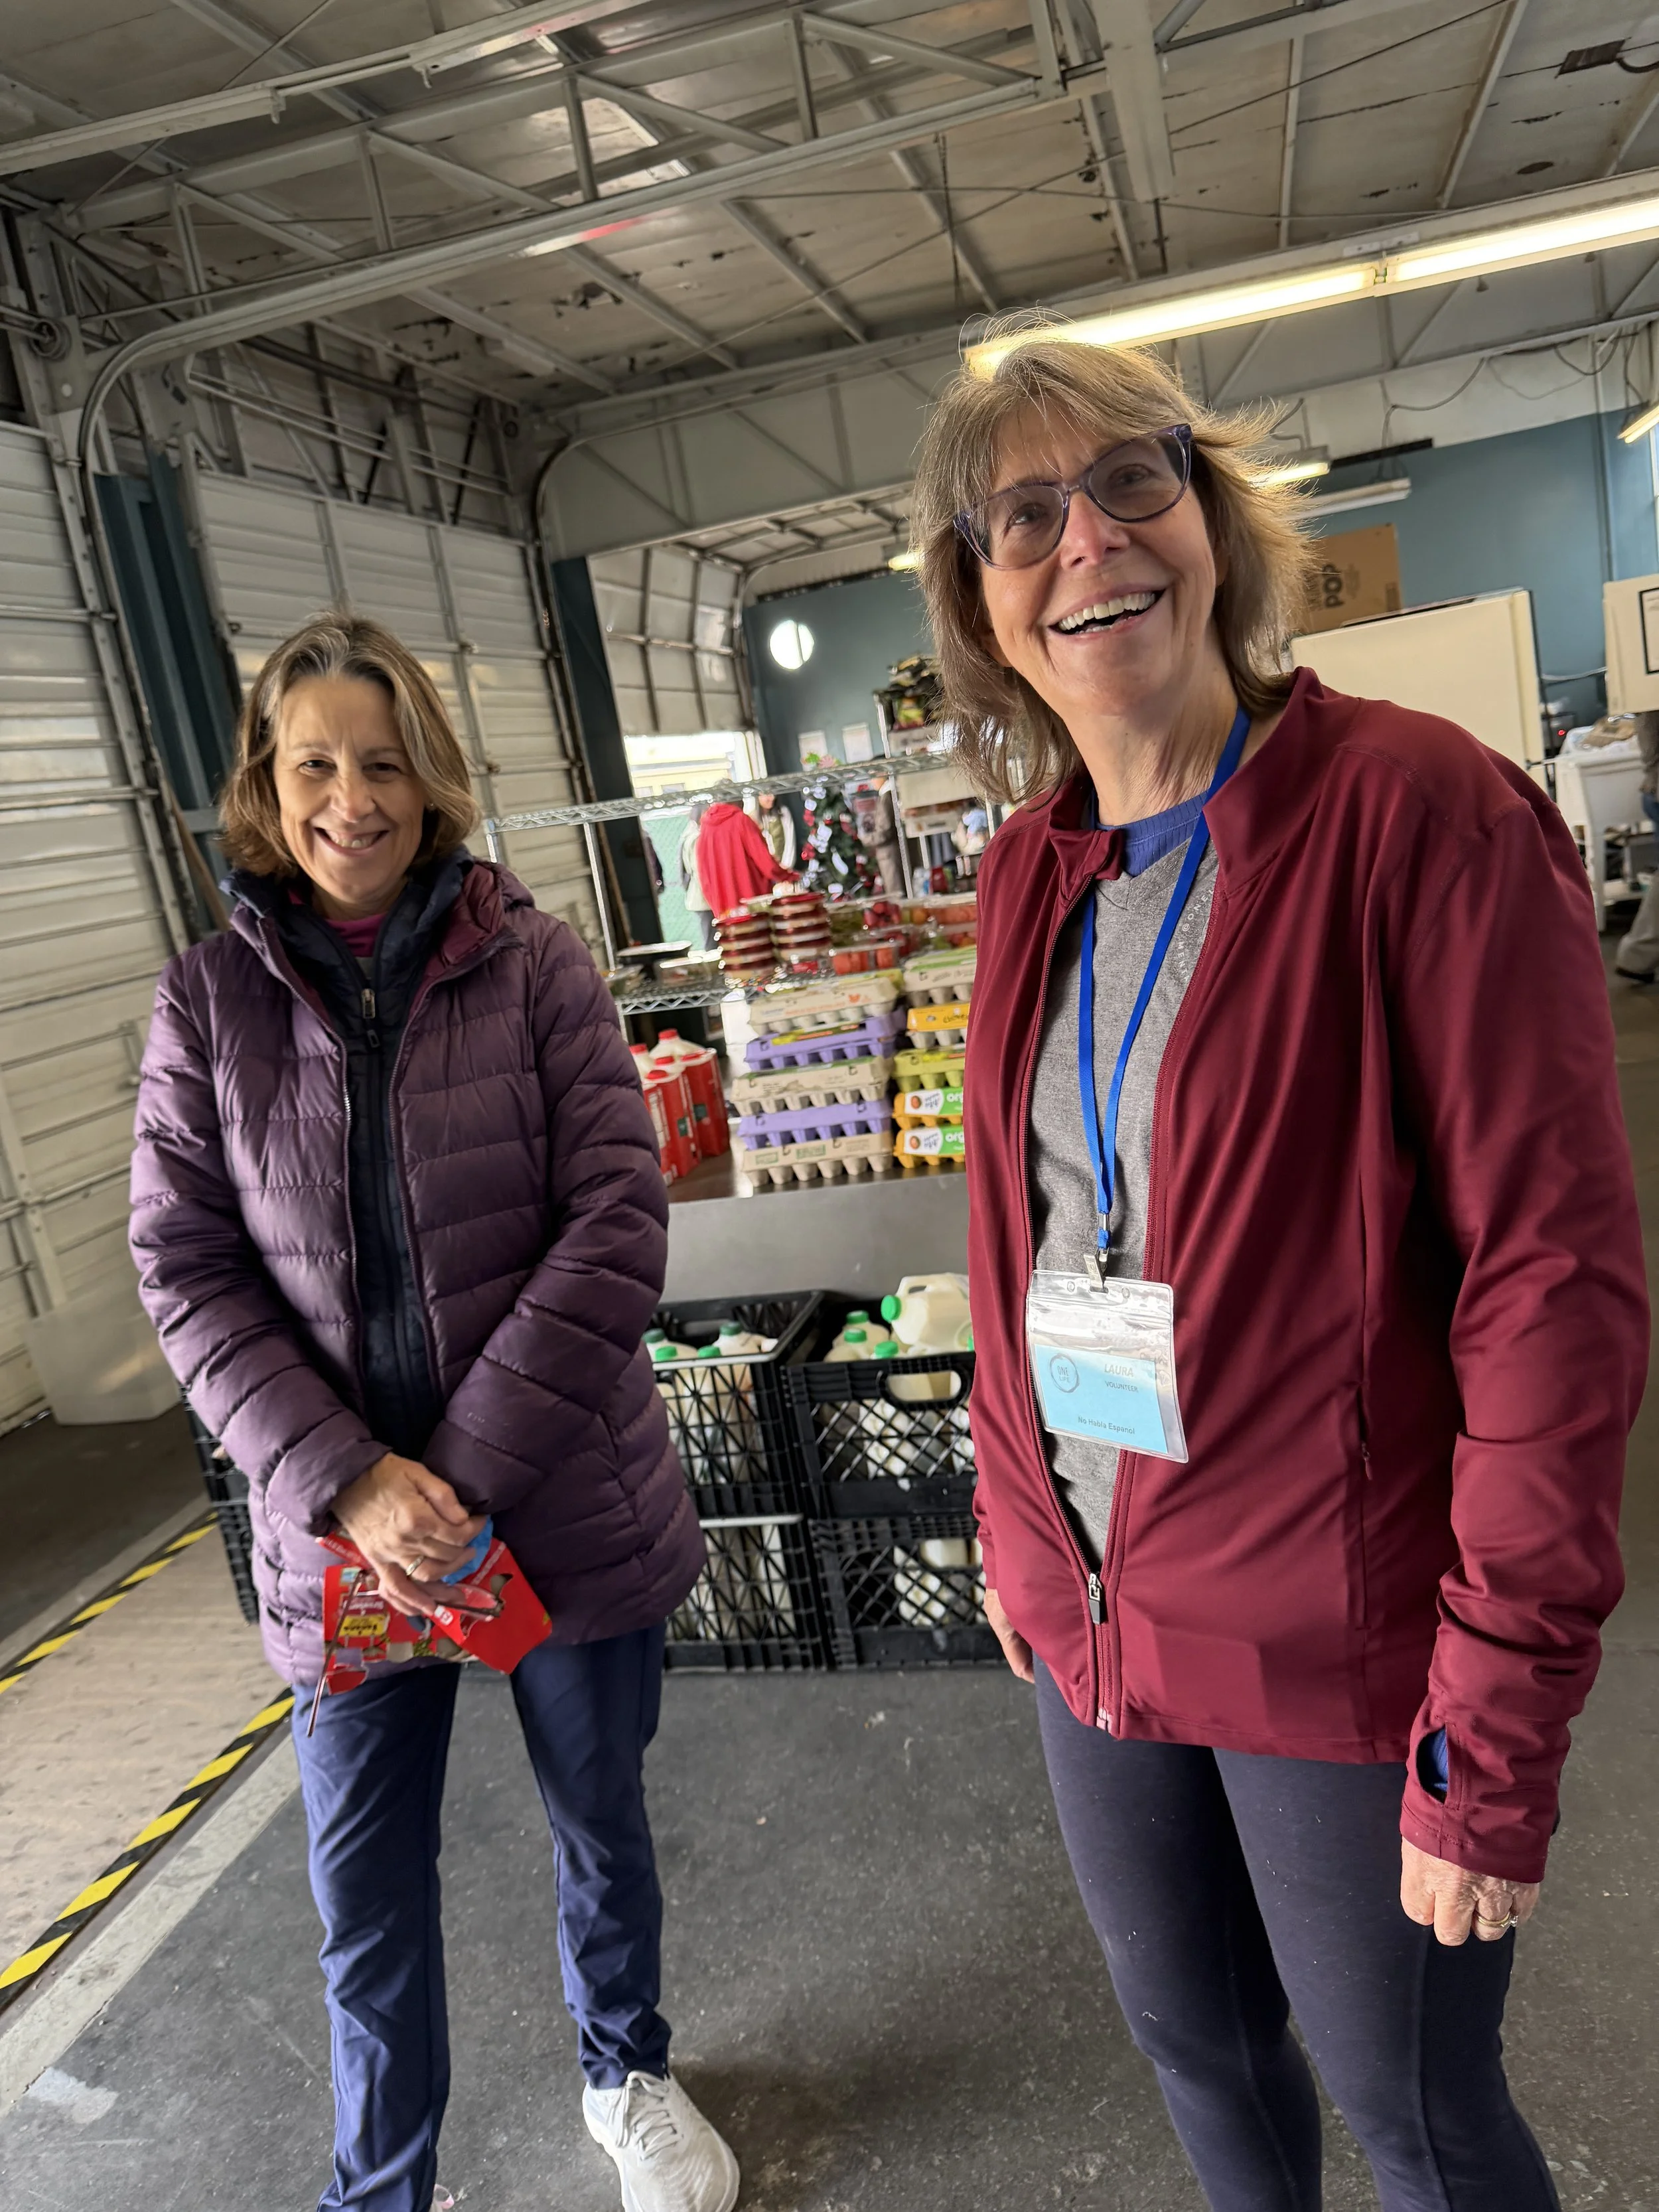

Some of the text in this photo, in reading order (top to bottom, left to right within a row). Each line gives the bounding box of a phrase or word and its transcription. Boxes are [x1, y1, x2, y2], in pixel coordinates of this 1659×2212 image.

[1322, 563, 1344, 608] POP
[1057, 1365, 1069, 1376] ONE
[1104, 1364, 1134, 1377] LAURA
[1105, 1380, 1139, 1393] VOLUNTEER
[1078, 1416, 1135, 1434] No Habla Espanol
